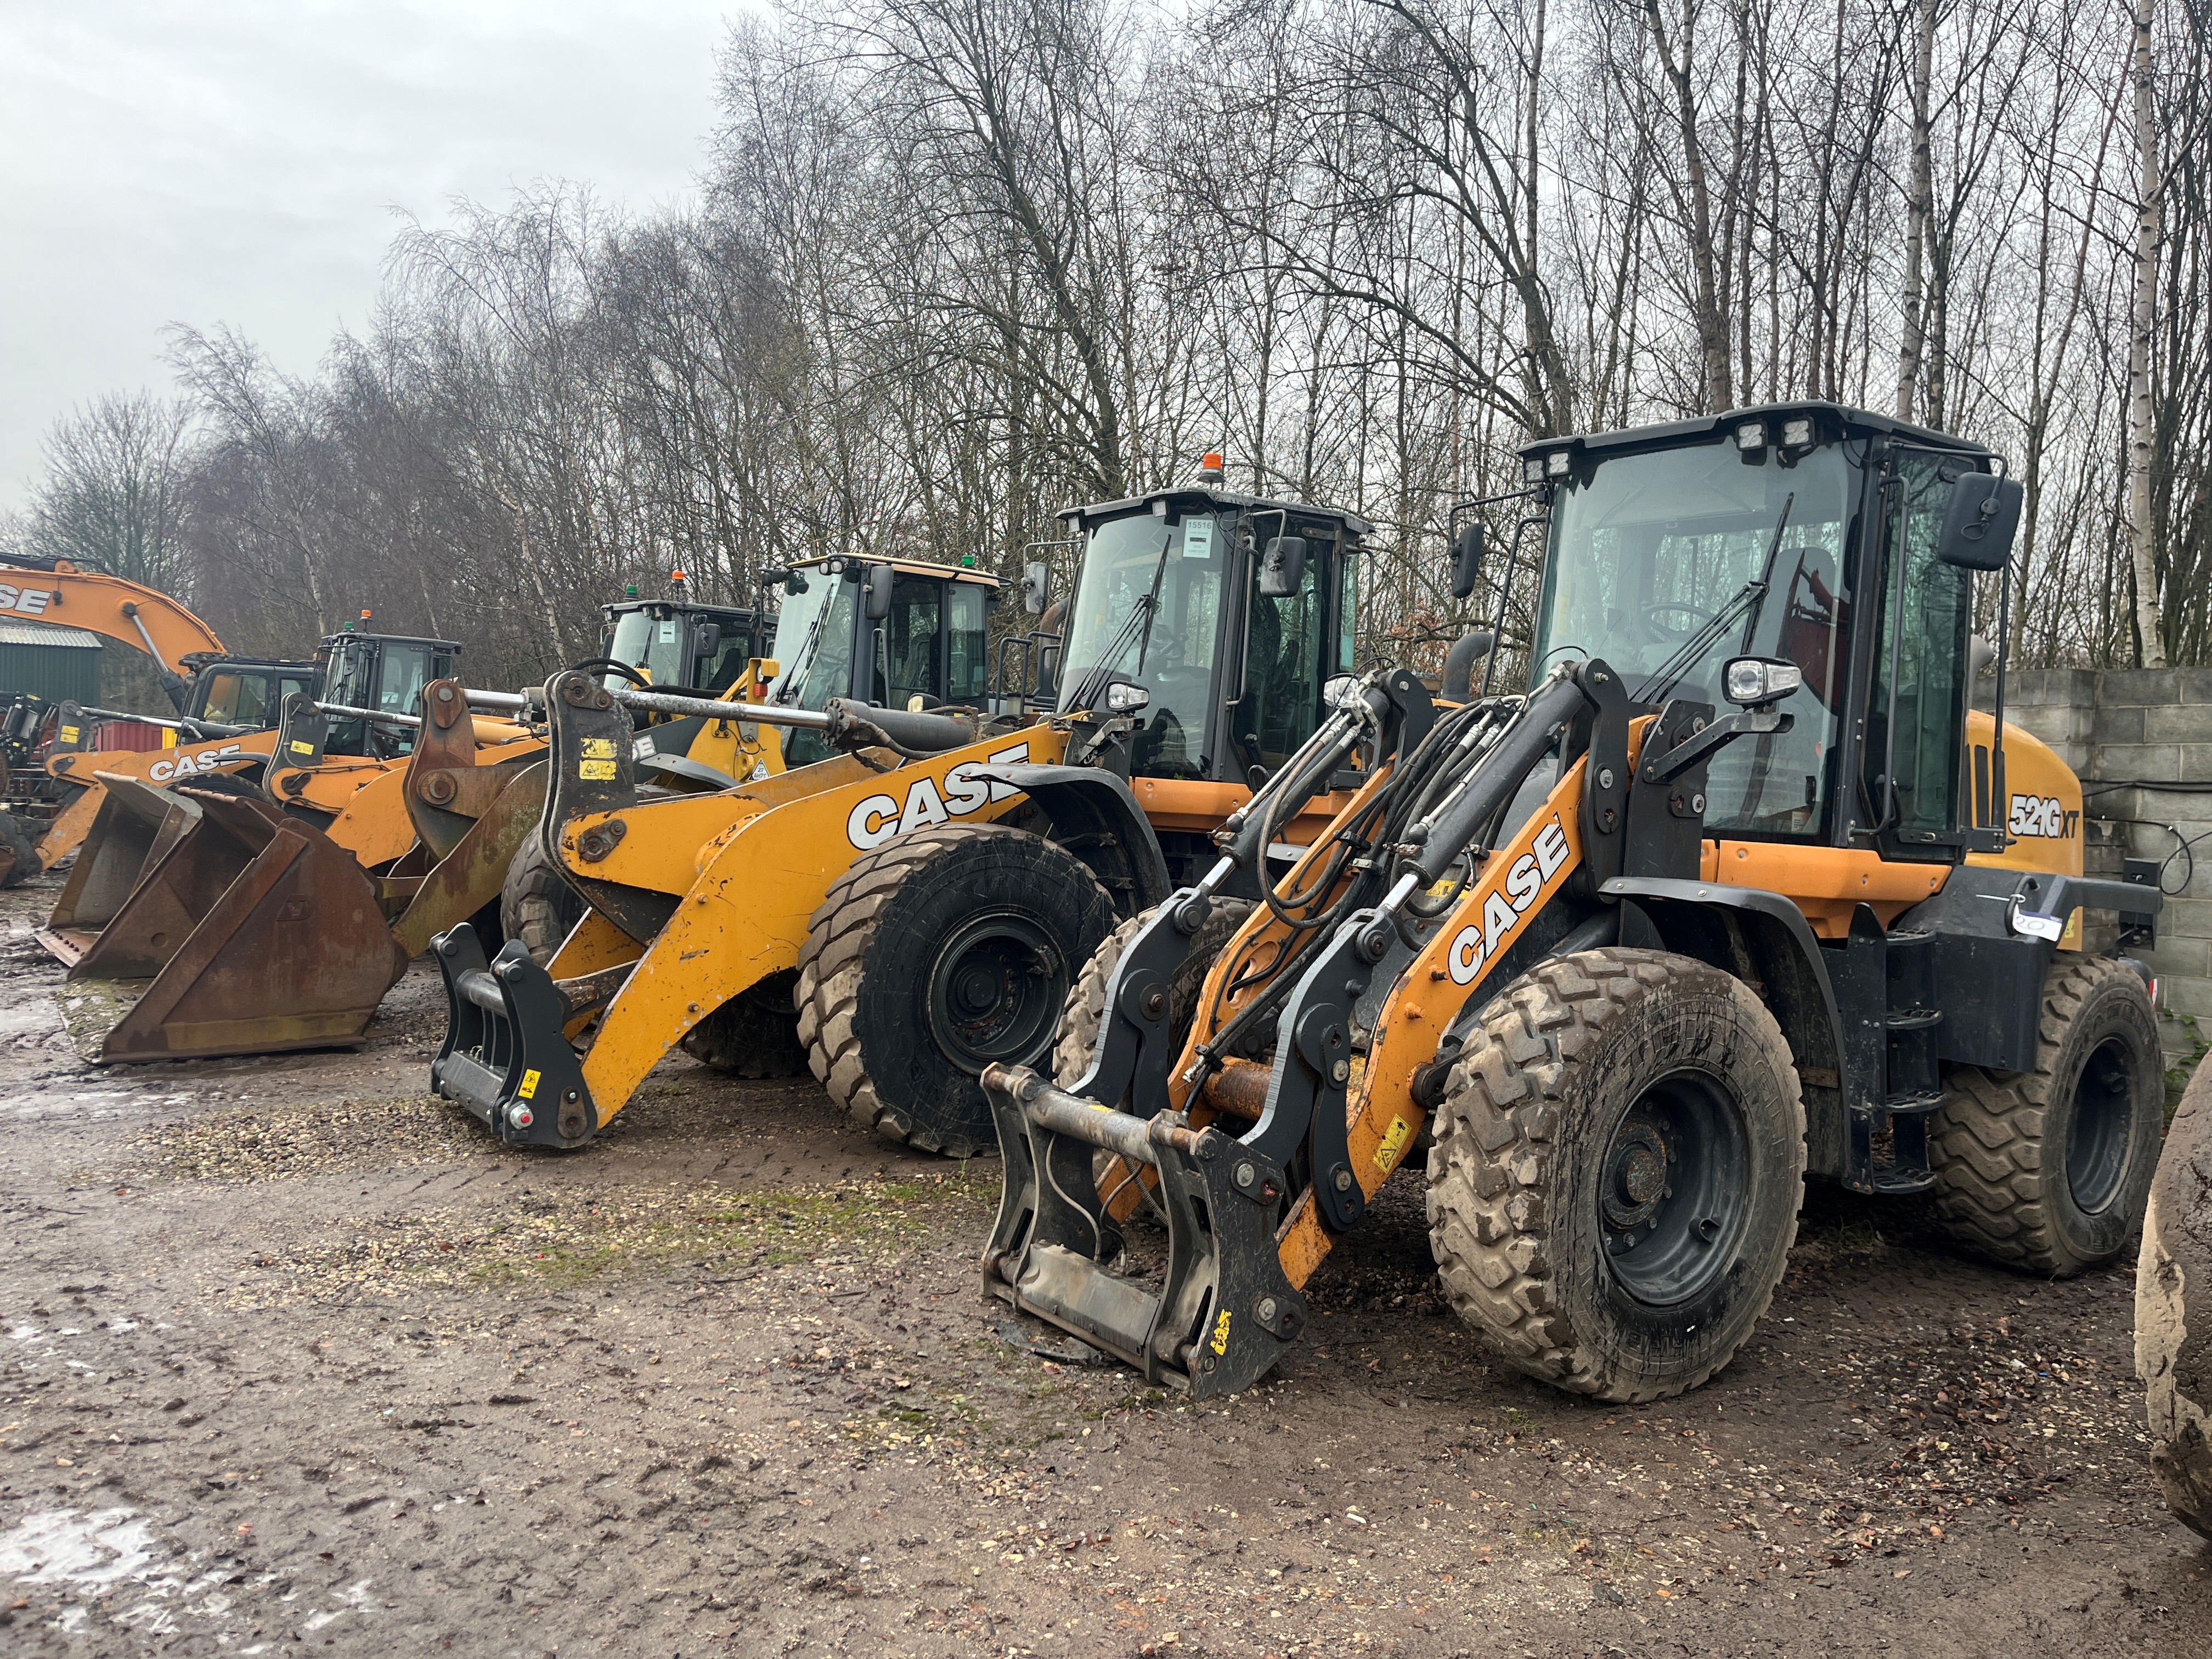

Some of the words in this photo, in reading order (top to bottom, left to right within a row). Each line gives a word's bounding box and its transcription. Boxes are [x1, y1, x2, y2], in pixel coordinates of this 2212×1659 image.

[1188, 521, 1212, 529] 15516
[149, 743, 240, 781] CASE
[1448, 811, 1570, 985] CASE
